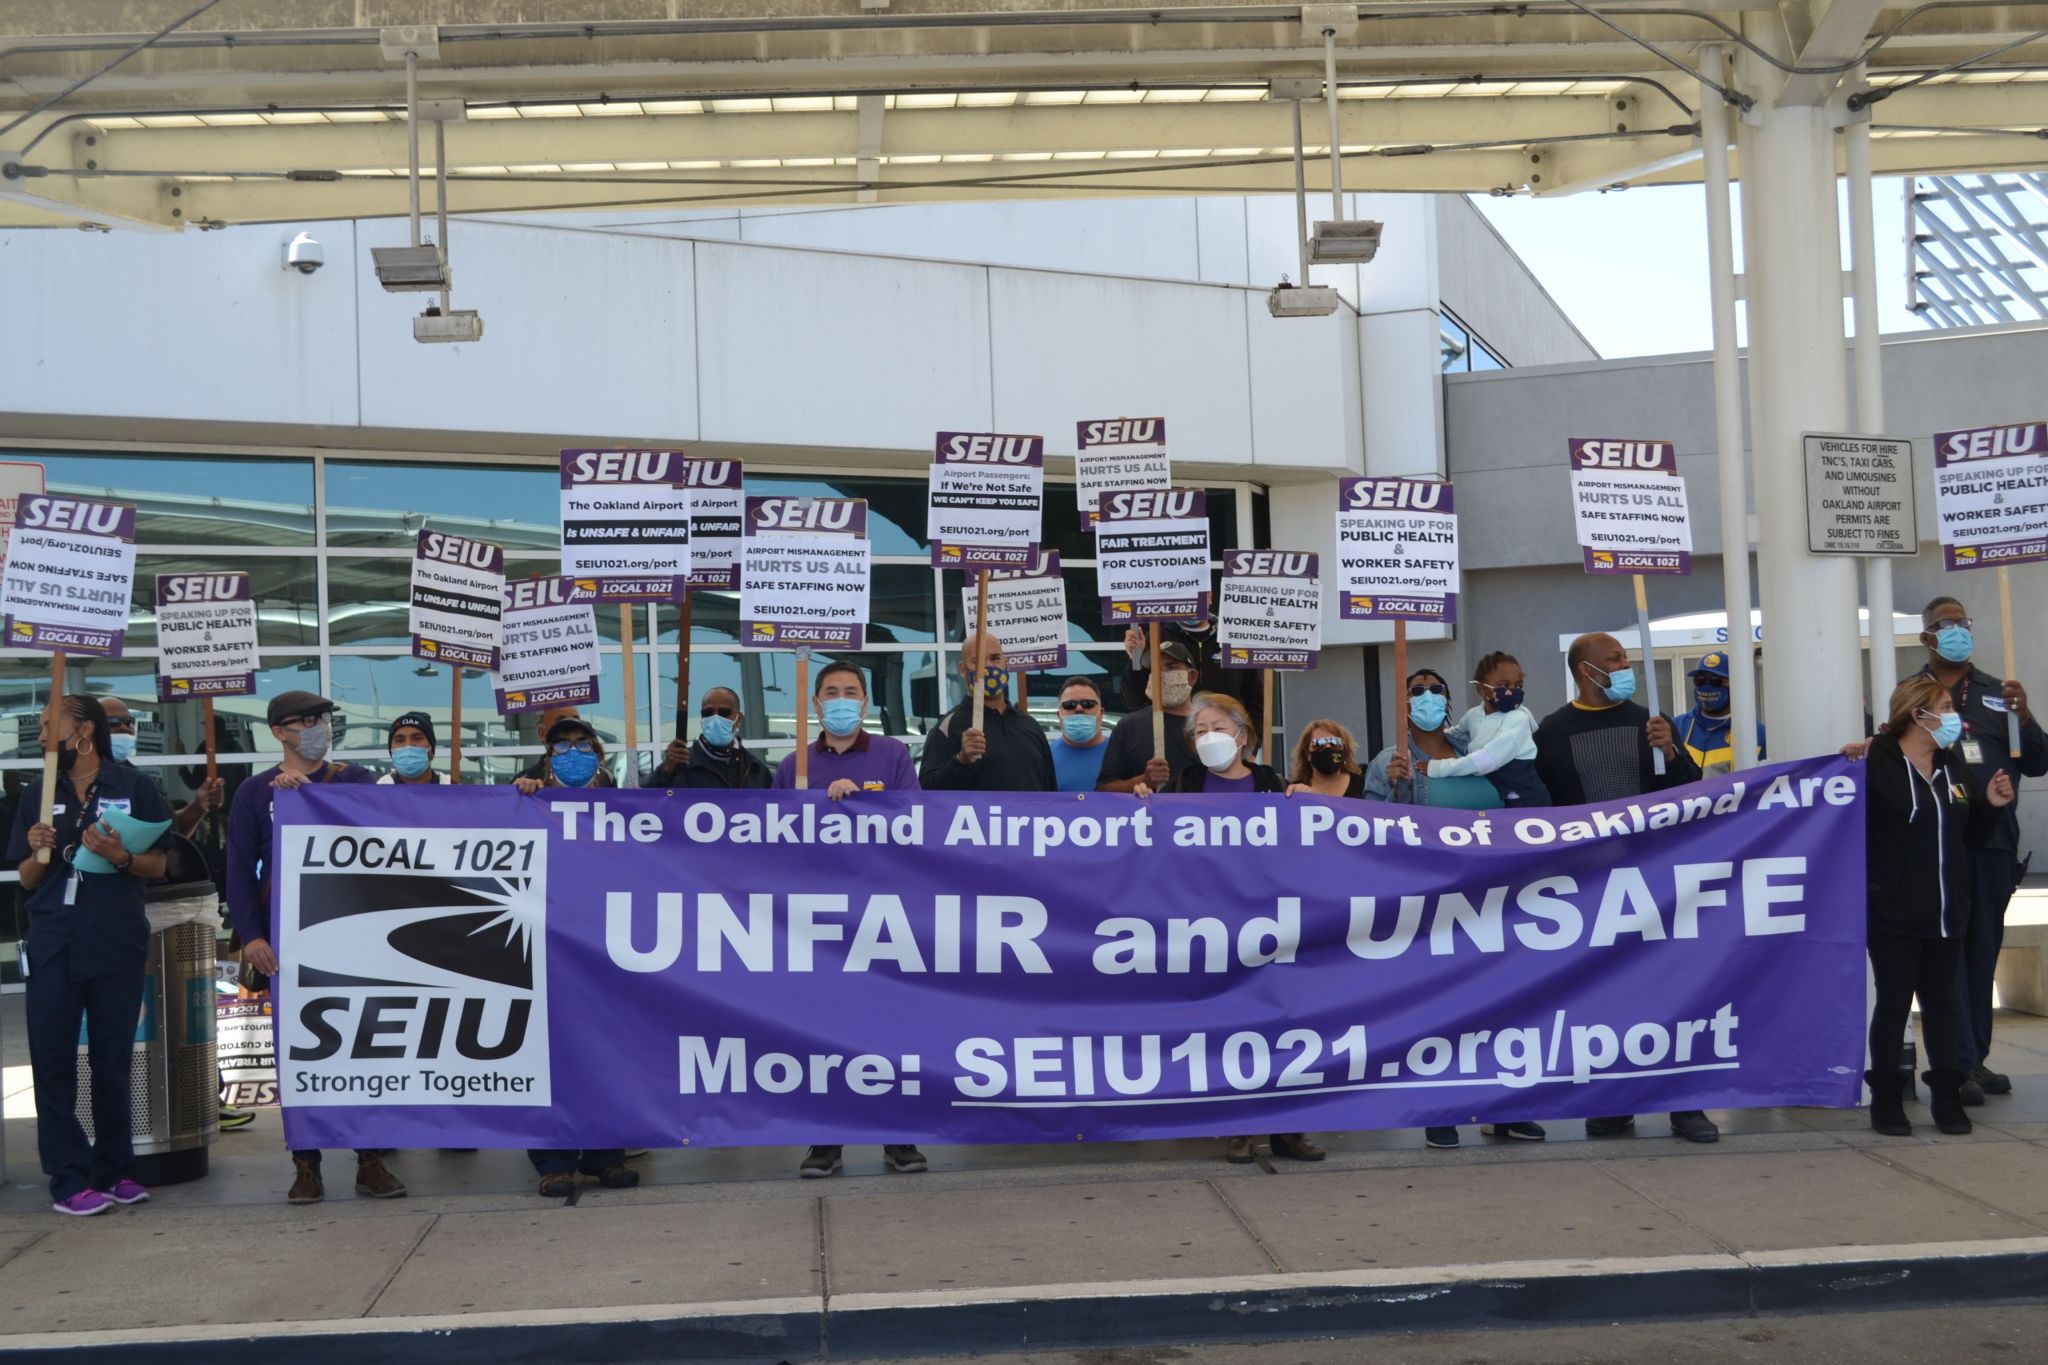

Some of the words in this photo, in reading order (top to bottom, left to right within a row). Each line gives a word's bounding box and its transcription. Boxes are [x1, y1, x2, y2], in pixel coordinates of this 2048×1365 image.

[1086, 420, 1155, 444] SEIU
[946, 435, 1032, 463] SEIU
[1820, 442, 1859, 452] VEHICLES
[1862, 444, 1877, 453] FOR
[1880, 445, 1898, 454] HIRE
[1947, 425, 2035, 461] SEIU
[1110, 453, 1166, 461] MISMANAGEMENT
[1581, 441, 1662, 468] SEIU
[573, 453, 669, 481] SEIU
[1851, 458, 1869, 467] TAXI
[944, 470, 976, 478] Airport
[978, 471, 1030, 480] Passengers:
[1080, 466, 1121, 475] HURTS
[1125, 464, 1140, 472] US
[1144, 463, 1166, 472] ALL
[1825, 471, 1843, 480] AND
[1847, 472, 1896, 482] LIMOUSINES
[1940, 469, 2004, 484] SPEAKING
[2007, 467, 2023, 476] UP
[952, 482, 983, 490] We're
[986, 484, 1006, 492] Not
[1008, 484, 1032, 492] Safe
[1104, 479, 1144, 487] STAFFING
[1614, 483, 1681, 492] MISMANAGEMENT
[1941, 482, 1993, 496] PUBLIC
[1351, 481, 1441, 509] SEIU
[1843, 486, 1880, 496] WITHOUT
[949, 496, 973, 504] CAN'T
[1579, 492, 1629, 504] HURTS
[1633, 495, 1652, 505] US
[1657, 496, 1683, 507] ALL
[1994, 493, 2003, 504] &
[569, 501, 590, 510] The
[593, 501, 640, 510] Oakland
[643, 501, 683, 511] Airport
[1110, 491, 1194, 519] SEIU
[1823, 500, 1864, 509] OAKLAND
[1867, 502, 1901, 511] AIRPORT
[25, 498, 123, 533] SEIU
[757, 500, 853, 529] SEIU
[1581, 511, 1607, 519] SAFE
[1609, 513, 1658, 521] STAFFING
[1661, 515, 1685, 523] NOW
[1836, 515, 1871, 524] PERMITS
[1874, 516, 1890, 525] ARE
[1943, 508, 2001, 522] WORKER
[1341, 519, 1405, 528] SPEAKING
[1409, 520, 1425, 528] UP
[1429, 521, 1453, 530] FOR
[567, 529, 577, 537] Is
[580, 529, 630, 538] UNSAFE
[631, 529, 639, 537] &
[642, 528, 686, 537] UNFAIR
[940, 526, 1029, 536] SEIU1021.org/port
[1828, 529, 1861, 538] SUBJECT
[1865, 530, 1875, 538] TO
[1878, 530, 1899, 539] FINES
[1101, 538, 1129, 548] FAIR
[1131, 535, 1205, 547] TREATMENT
[1341, 532, 1393, 541] PUBLIC
[1398, 532, 1453, 543] HEALTH
[1592, 533, 1680, 544] SEIU1021.org/port
[21, 537, 122, 558] SEIU1021.org/port
[425, 534, 495, 568] SEIU
[788, 549, 866, 557] MISMANAGEMENT
[1394, 544, 1404, 554] &
[9, 560, 35, 571] NOW
[576, 559, 678, 569] SEIU1021.org/port
[746, 560, 802, 572] HURTS
[807, 562, 829, 573] US
[834, 562, 866, 574] ALL
[1103, 560, 1126, 568] FOR
[1130, 557, 1206, 567] CUSTODIANS
[1233, 553, 1309, 575] SEIU
[1342, 559, 1401, 568] WORKER
[1405, 560, 1454, 570] SAFETY
[38, 564, 93, 578] STAFFING
[97, 572, 128, 583] SAFE
[417, 570, 431, 579] The
[434, 574, 467, 586] Oakland
[470, 580, 498, 592] Airport
[1351, 577, 1447, 586] SEIU1021.org/port
[7, 578, 35, 592] ALL
[40, 583, 61, 595] US
[167, 576, 239, 601] SEIU
[603, 584, 642, 593] LOCAL
[646, 584, 672, 593] 1021
[745, 581, 774, 590] SAFE
[778, 582, 833, 591] STAFFING
[837, 584, 865, 592] NOW
[1111, 579, 1199, 590] SEIU1021.org/port
[67, 587, 125, 604] HURTS
[1225, 584, 1278, 594] SPEAKING
[1281, 588, 1295, 596] UP
[1298, 590, 1319, 598] FOR
[5, 596, 80, 612] MISMANAGEMENT
[424, 594, 459, 608] UNSAFE
[468, 602, 499, 615] UNFAIR
[1224, 594, 1267, 604] PUBLIC
[1271, 598, 1318, 609] HEALTH
[1378, 602, 1416, 611] LOCAL
[1420, 603, 1443, 613] 1021
[82, 607, 123, 617] AIRPORT
[160, 610, 212, 620] SPEAKING
[754, 606, 855, 617] SEIU1021.org/port
[162, 622, 203, 632] PUBLIC
[207, 618, 251, 629] HEALTH
[523, 612, 589, 626] MISMANAGEMENT
[1223, 617, 1270, 628] WORKER
[1274, 621, 1316, 631] SAFETY
[419, 621, 493, 640] SEIU1021.org/port
[781, 630, 820, 639] LOCAL
[825, 631, 850, 640] 1021
[1228, 632, 1308, 644] SEIU1021.org/port
[164, 646, 210, 655] WORKER
[213, 642, 253, 652] SAFETY
[171, 658, 248, 669] SEIU1021.org/port
[503, 663, 590, 682] SEIU1021.org/port
[551, 801, 663, 842] The
[683, 802, 924, 845] Oakland
[944, 805, 1153, 856] Airport
[1173, 807, 1278, 846] and
[1300, 805, 1422, 846] Port
[1438, 820, 1492, 846] of
[1513, 782, 1745, 845] Oakland
[1756, 775, 1856, 810] Are
[302, 836, 435, 870] LOCAL
[452, 839, 535, 871] 1021
[605, 891, 1053, 974] UNFAIR
[1093, 897, 1301, 975] and
[1346, 856, 1807, 959] UNSAFE
[289, 996, 532, 1061] SEIU
[679, 1036, 920, 1096] More:
[954, 1002, 1738, 1097] SEIU1021.org/port
[296, 1071, 410, 1097] Stronger
[420, 1070, 534, 1097] Together
